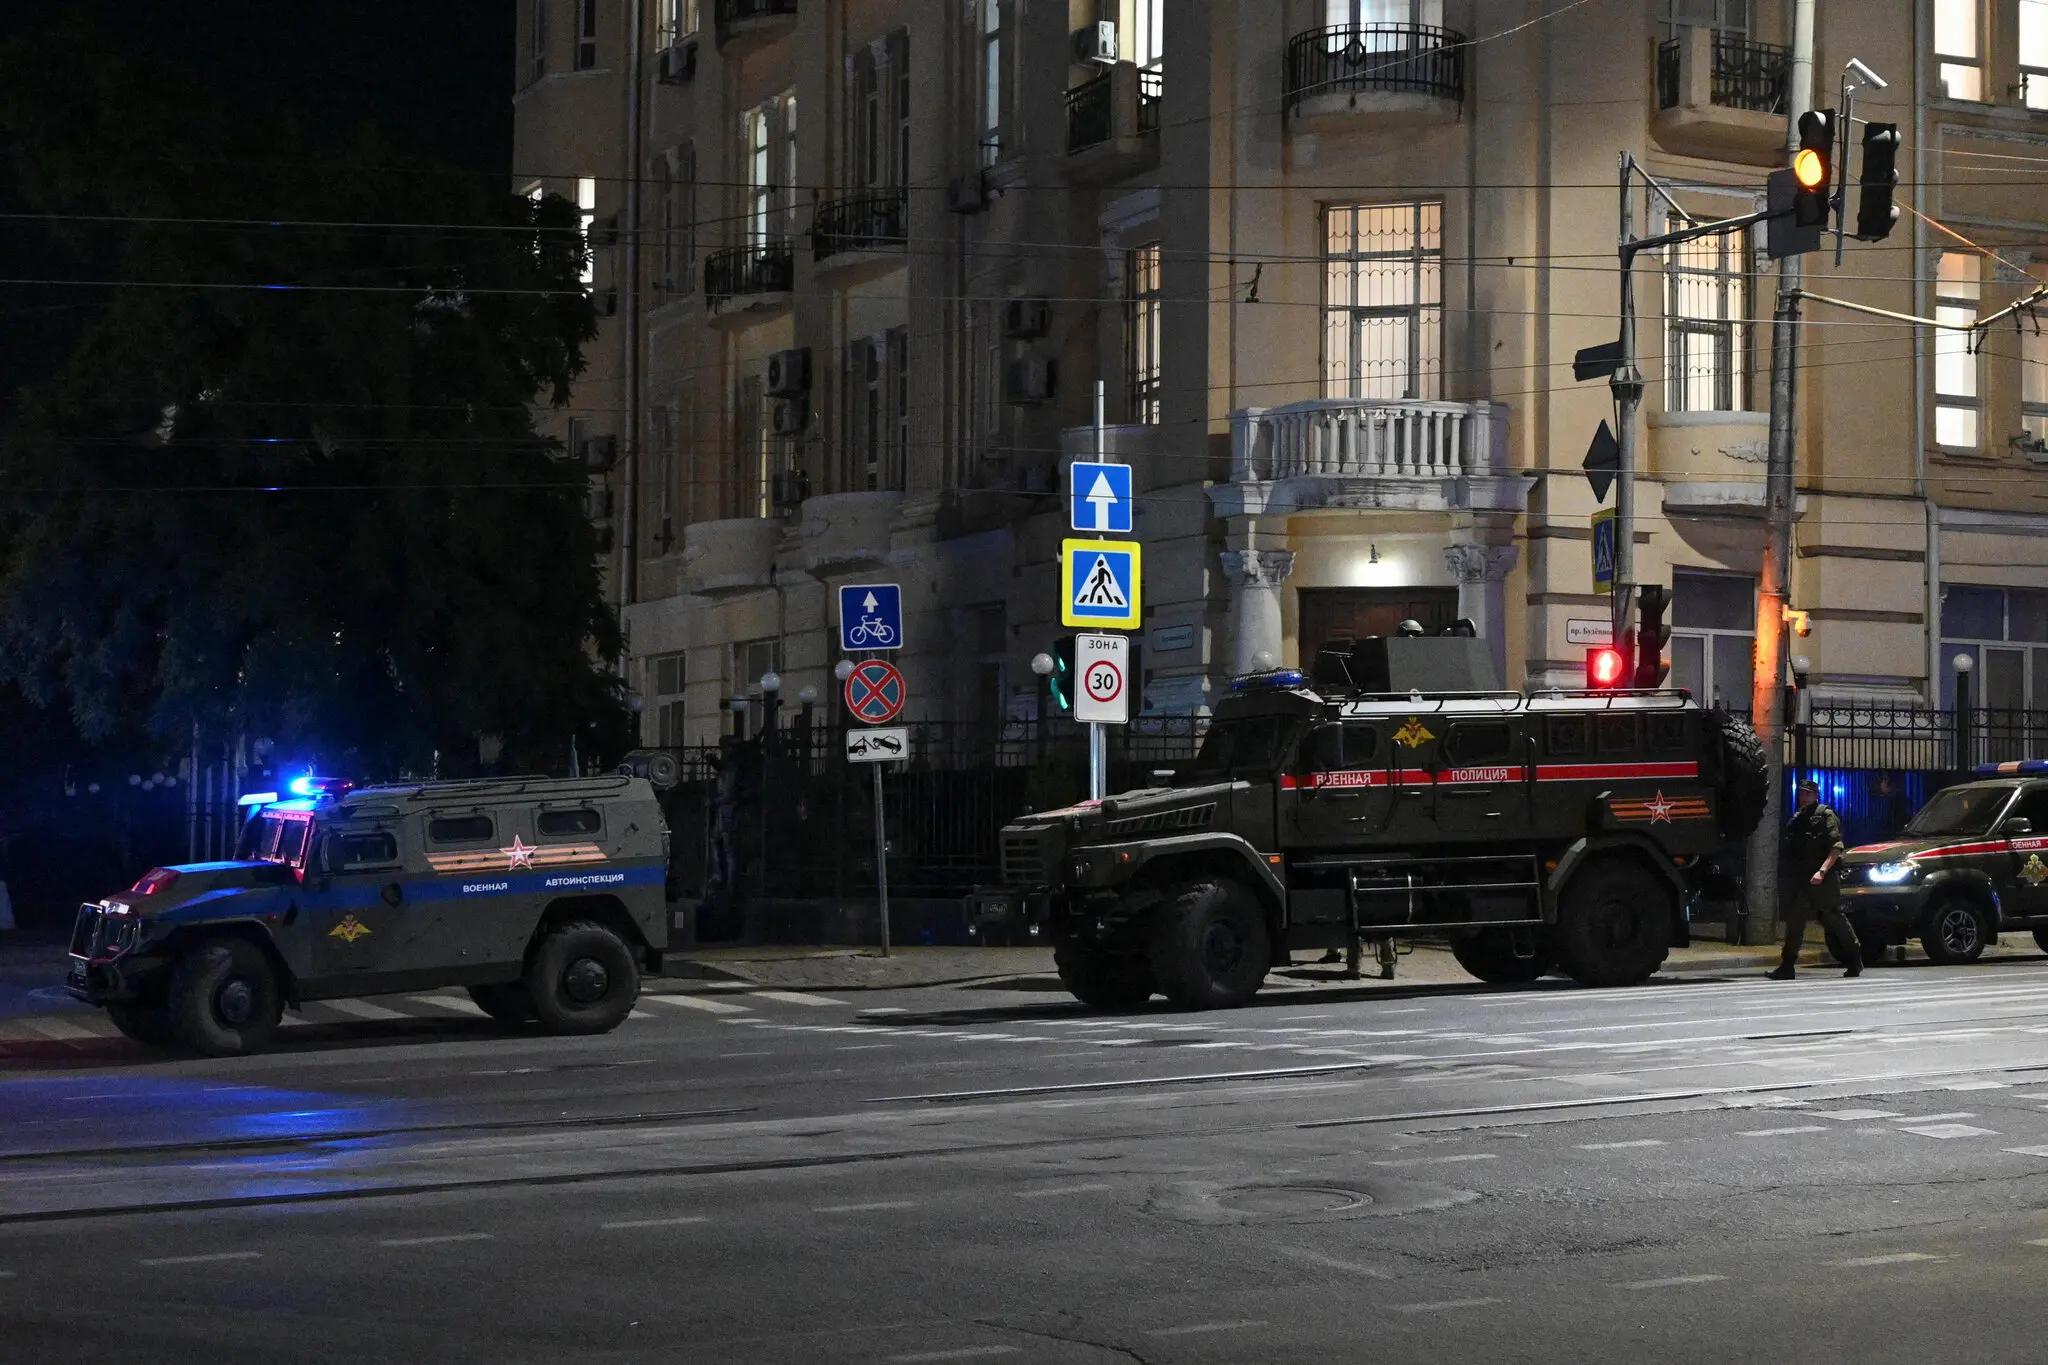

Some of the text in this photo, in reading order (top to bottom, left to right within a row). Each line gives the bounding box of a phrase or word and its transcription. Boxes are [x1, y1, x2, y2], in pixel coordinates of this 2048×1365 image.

[1088, 639, 1119, 650] ЗОНА
[1092, 672, 1114, 690] 30
[1452, 768, 1509, 782] ПОЛИЦИЯ
[463, 873, 624, 893] ВОЕННАЯ АВТОИНСПЕКЦИЯ
